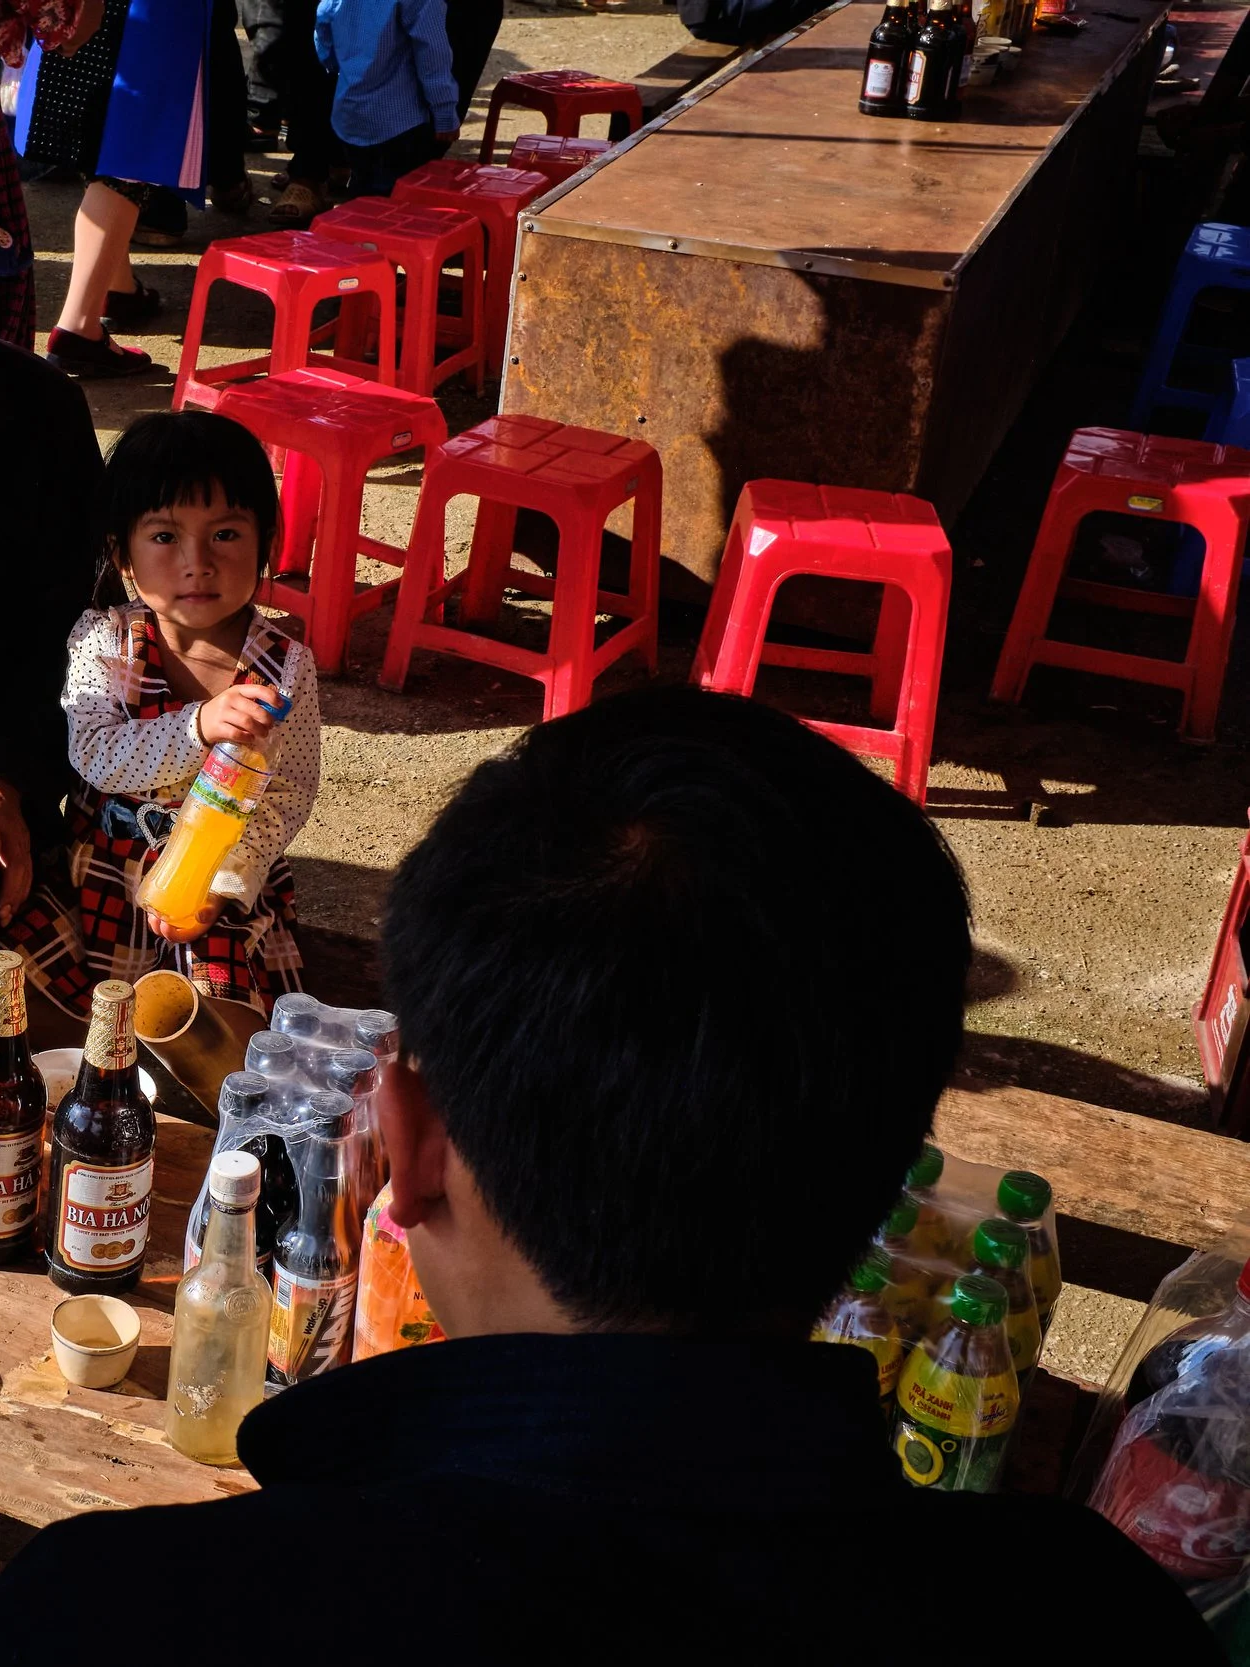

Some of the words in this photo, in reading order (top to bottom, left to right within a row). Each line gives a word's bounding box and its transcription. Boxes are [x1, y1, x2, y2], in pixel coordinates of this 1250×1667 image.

[66, 1204, 97, 1228] BIA
[102, 1208, 129, 1228] HÀ
[917, 1401, 951, 1421] CHANH
[928, 1393, 954, 1412] XANH
